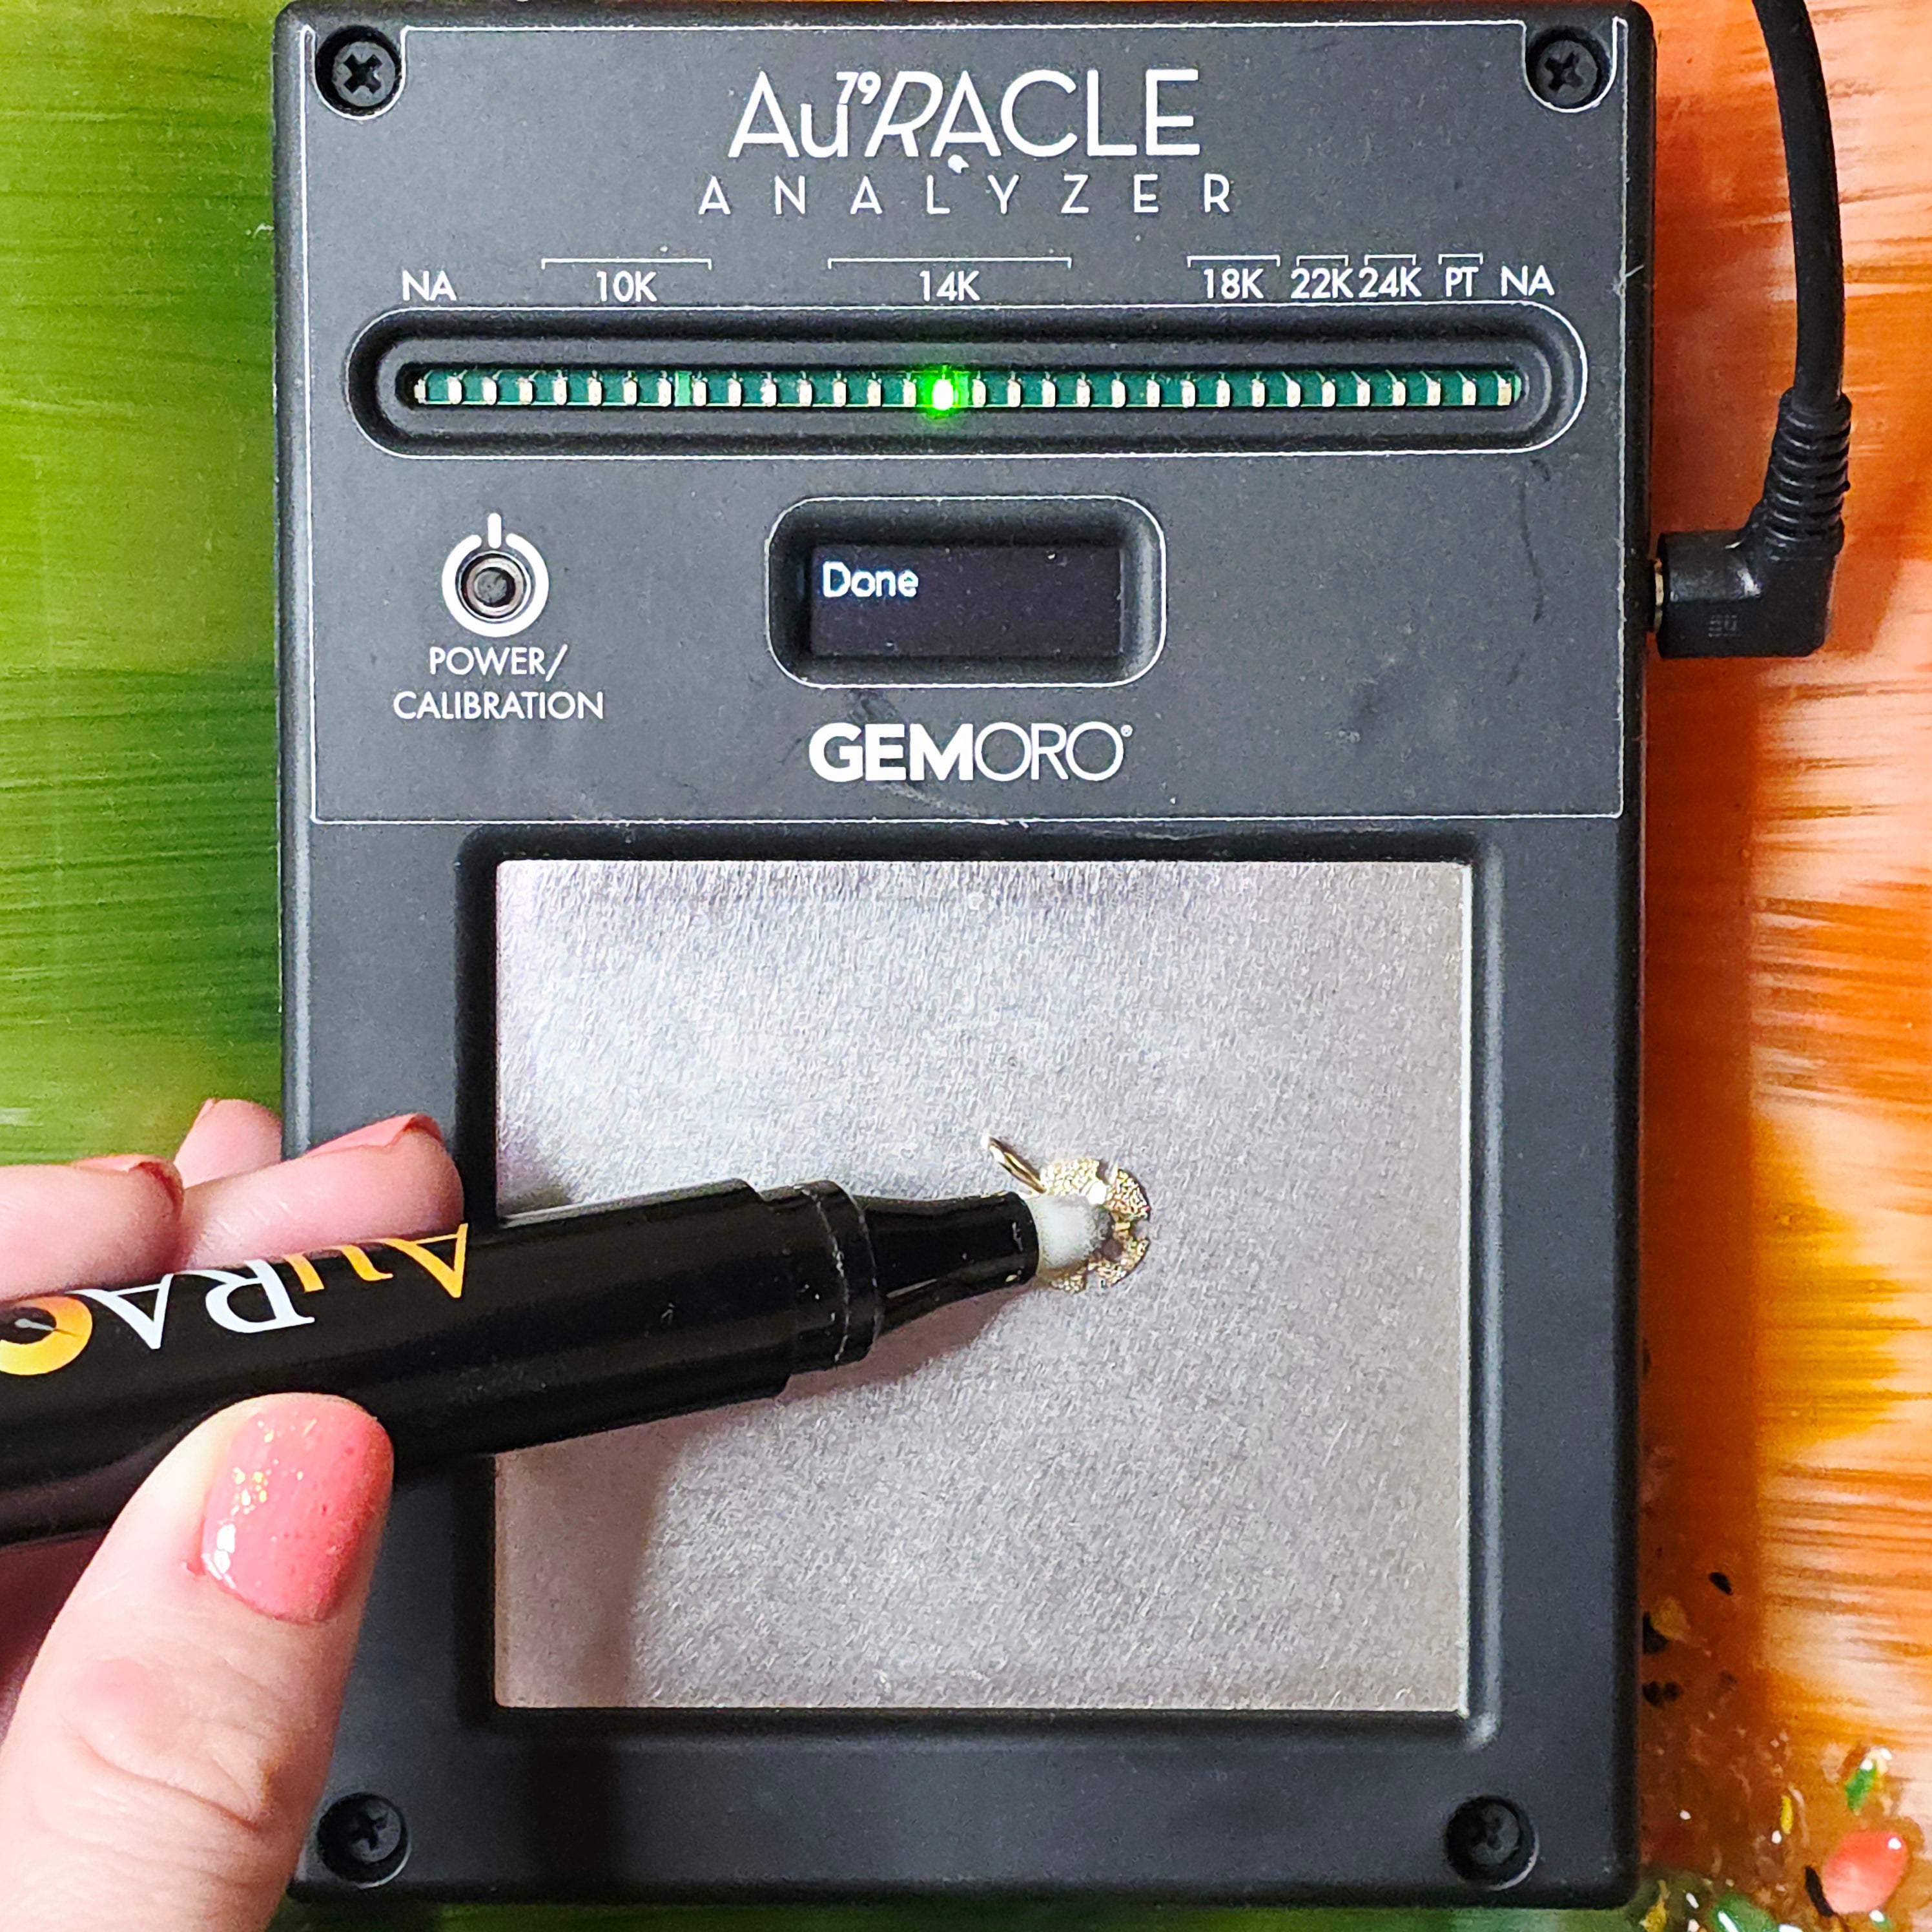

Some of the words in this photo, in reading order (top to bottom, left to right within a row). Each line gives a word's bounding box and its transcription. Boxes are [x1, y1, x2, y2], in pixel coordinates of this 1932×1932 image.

[698, 173, 1231, 216] ANALYZER
[401, 270, 458, 302] NA
[595, 271, 657, 302] 10K
[919, 270, 981, 302] 14K
[1202, 267, 1264, 299] 18K
[1291, 267, 1353, 299] 22K
[1358, 266, 1423, 298] 24K
[1444, 265, 1479, 298] PT
[1500, 265, 1555, 296] NA
[822, 560, 920, 598] Done
[429, 643, 568, 682] POWER/
[393, 691, 604, 720] CALIBRATION
